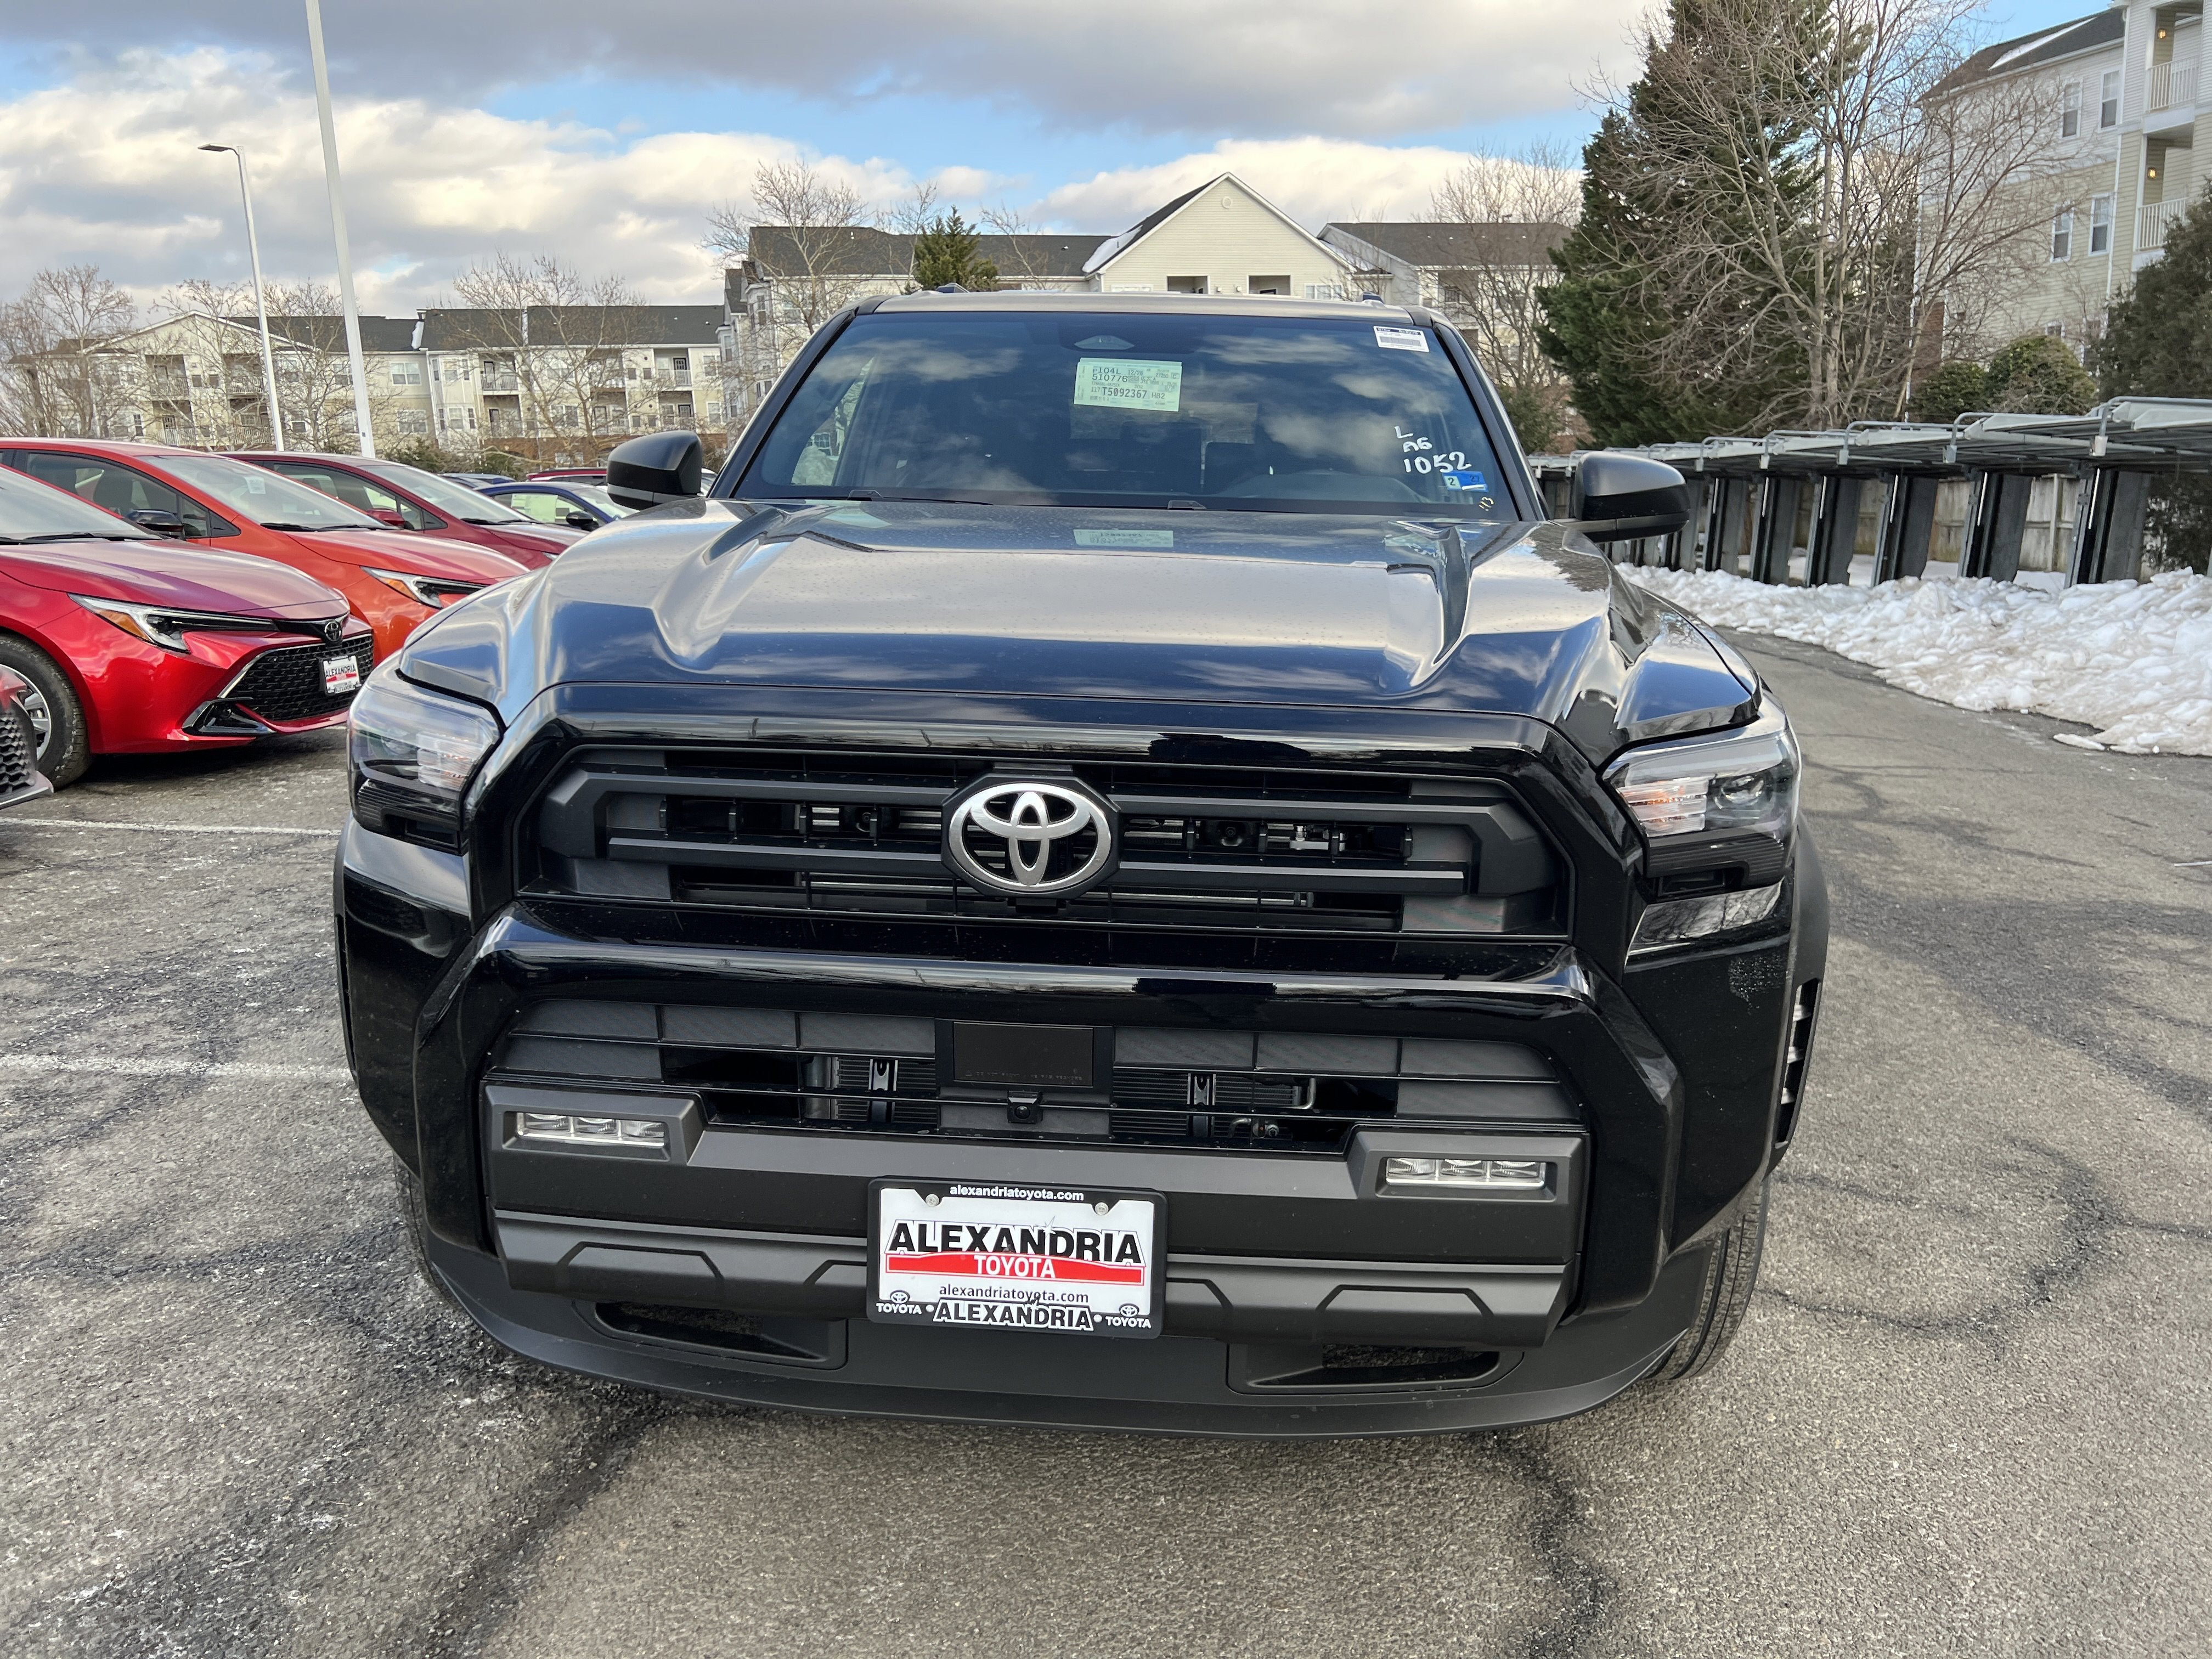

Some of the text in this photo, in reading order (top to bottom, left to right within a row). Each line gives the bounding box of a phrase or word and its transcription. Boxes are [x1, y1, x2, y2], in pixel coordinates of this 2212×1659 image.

[1092, 374, 1128, 382] 510776
[1102, 387, 1147, 398] T5092367
[1403, 451, 1472, 475] 1052
[1448, 477, 1456, 486] 2
[949, 1184, 1085, 1201] alexandriatoyota.com
[888, 1221, 1143, 1265] ALEXANDRIA
[973, 1254, 1056, 1278] TOYOTA
[939, 1283, 1089, 1304] alexandriatoyota.com
[876, 1302, 922, 1315] TOYOTA
[933, 1298, 1094, 1331] ALEXANDRIA
[1105, 1315, 1152, 1329] TOYOTA
